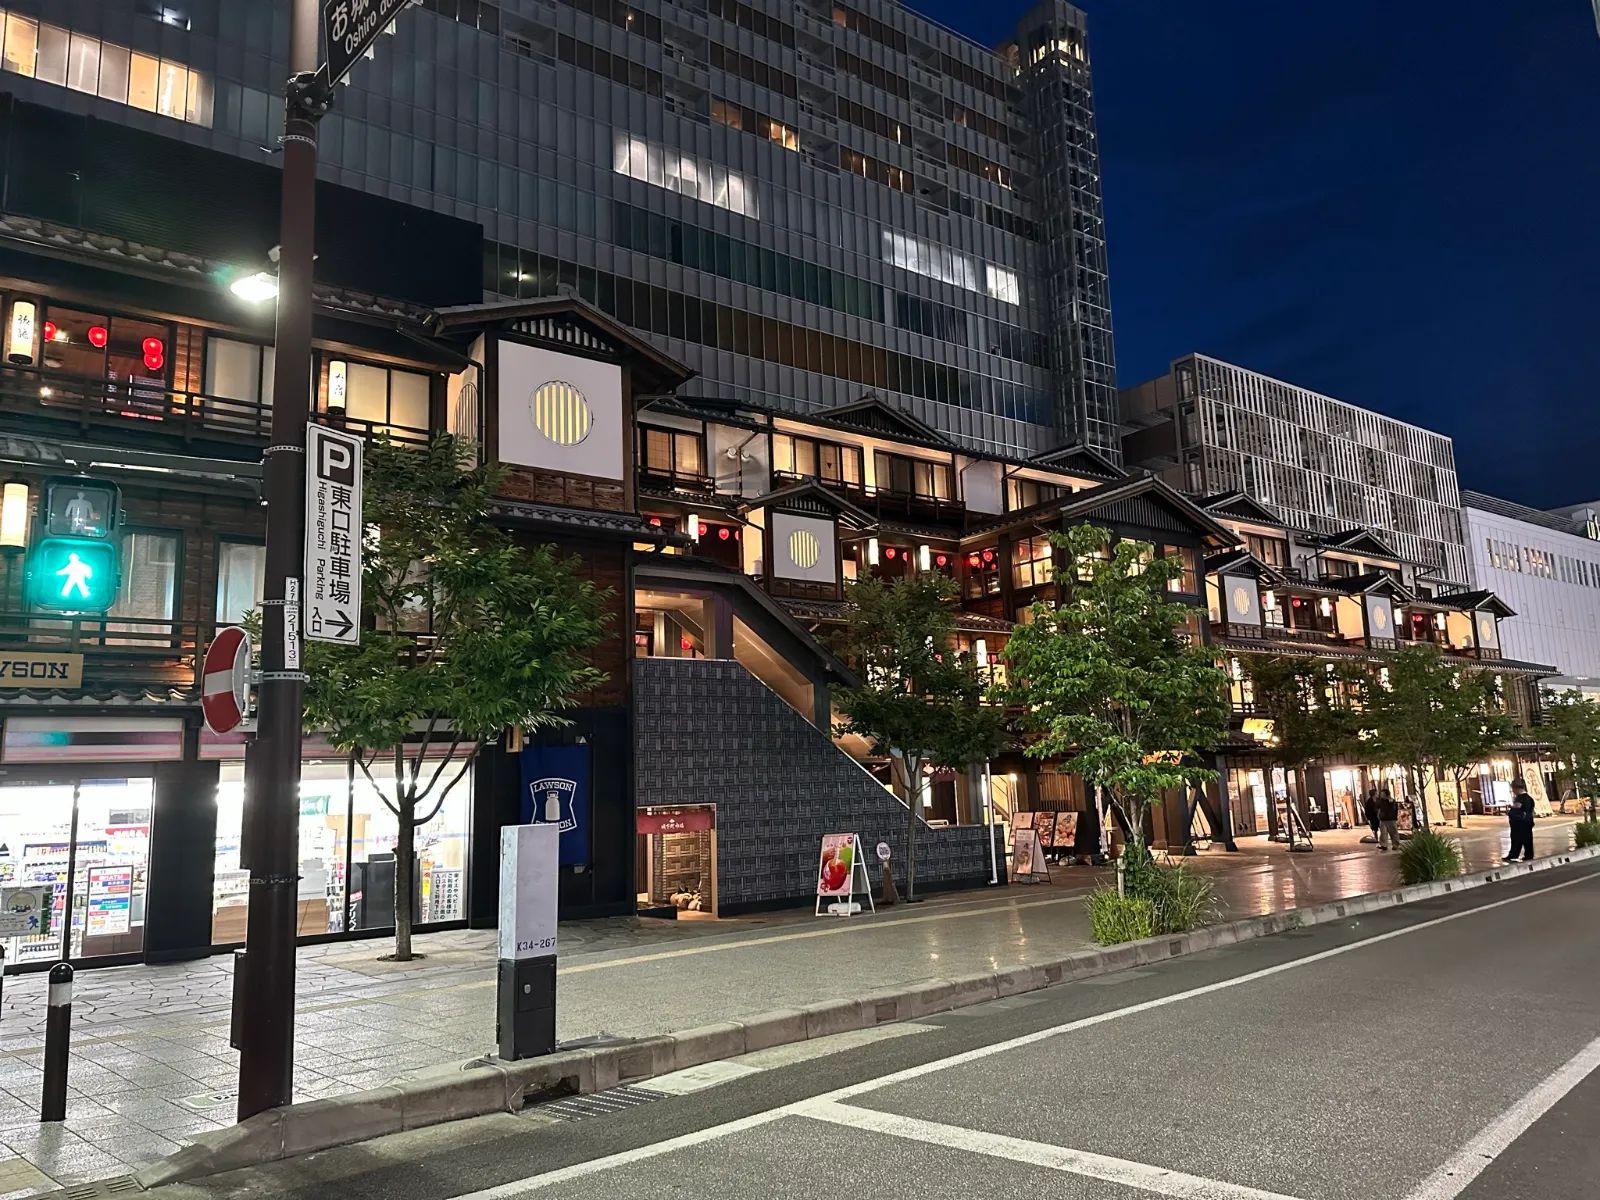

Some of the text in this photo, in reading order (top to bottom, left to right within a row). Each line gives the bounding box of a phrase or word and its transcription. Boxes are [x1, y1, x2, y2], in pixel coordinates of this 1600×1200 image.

[345, 10, 376, 54] Oshiro
[323, 440, 350, 477] P
[315, 480, 327, 600] Higashiguchi Parking
[329, 485, 351, 605] 東口駐車場
[312, 606, 322, 633] 入口
[534, 782, 573, 792] LAWSON
[517, 937, 556, 952] K34-267
